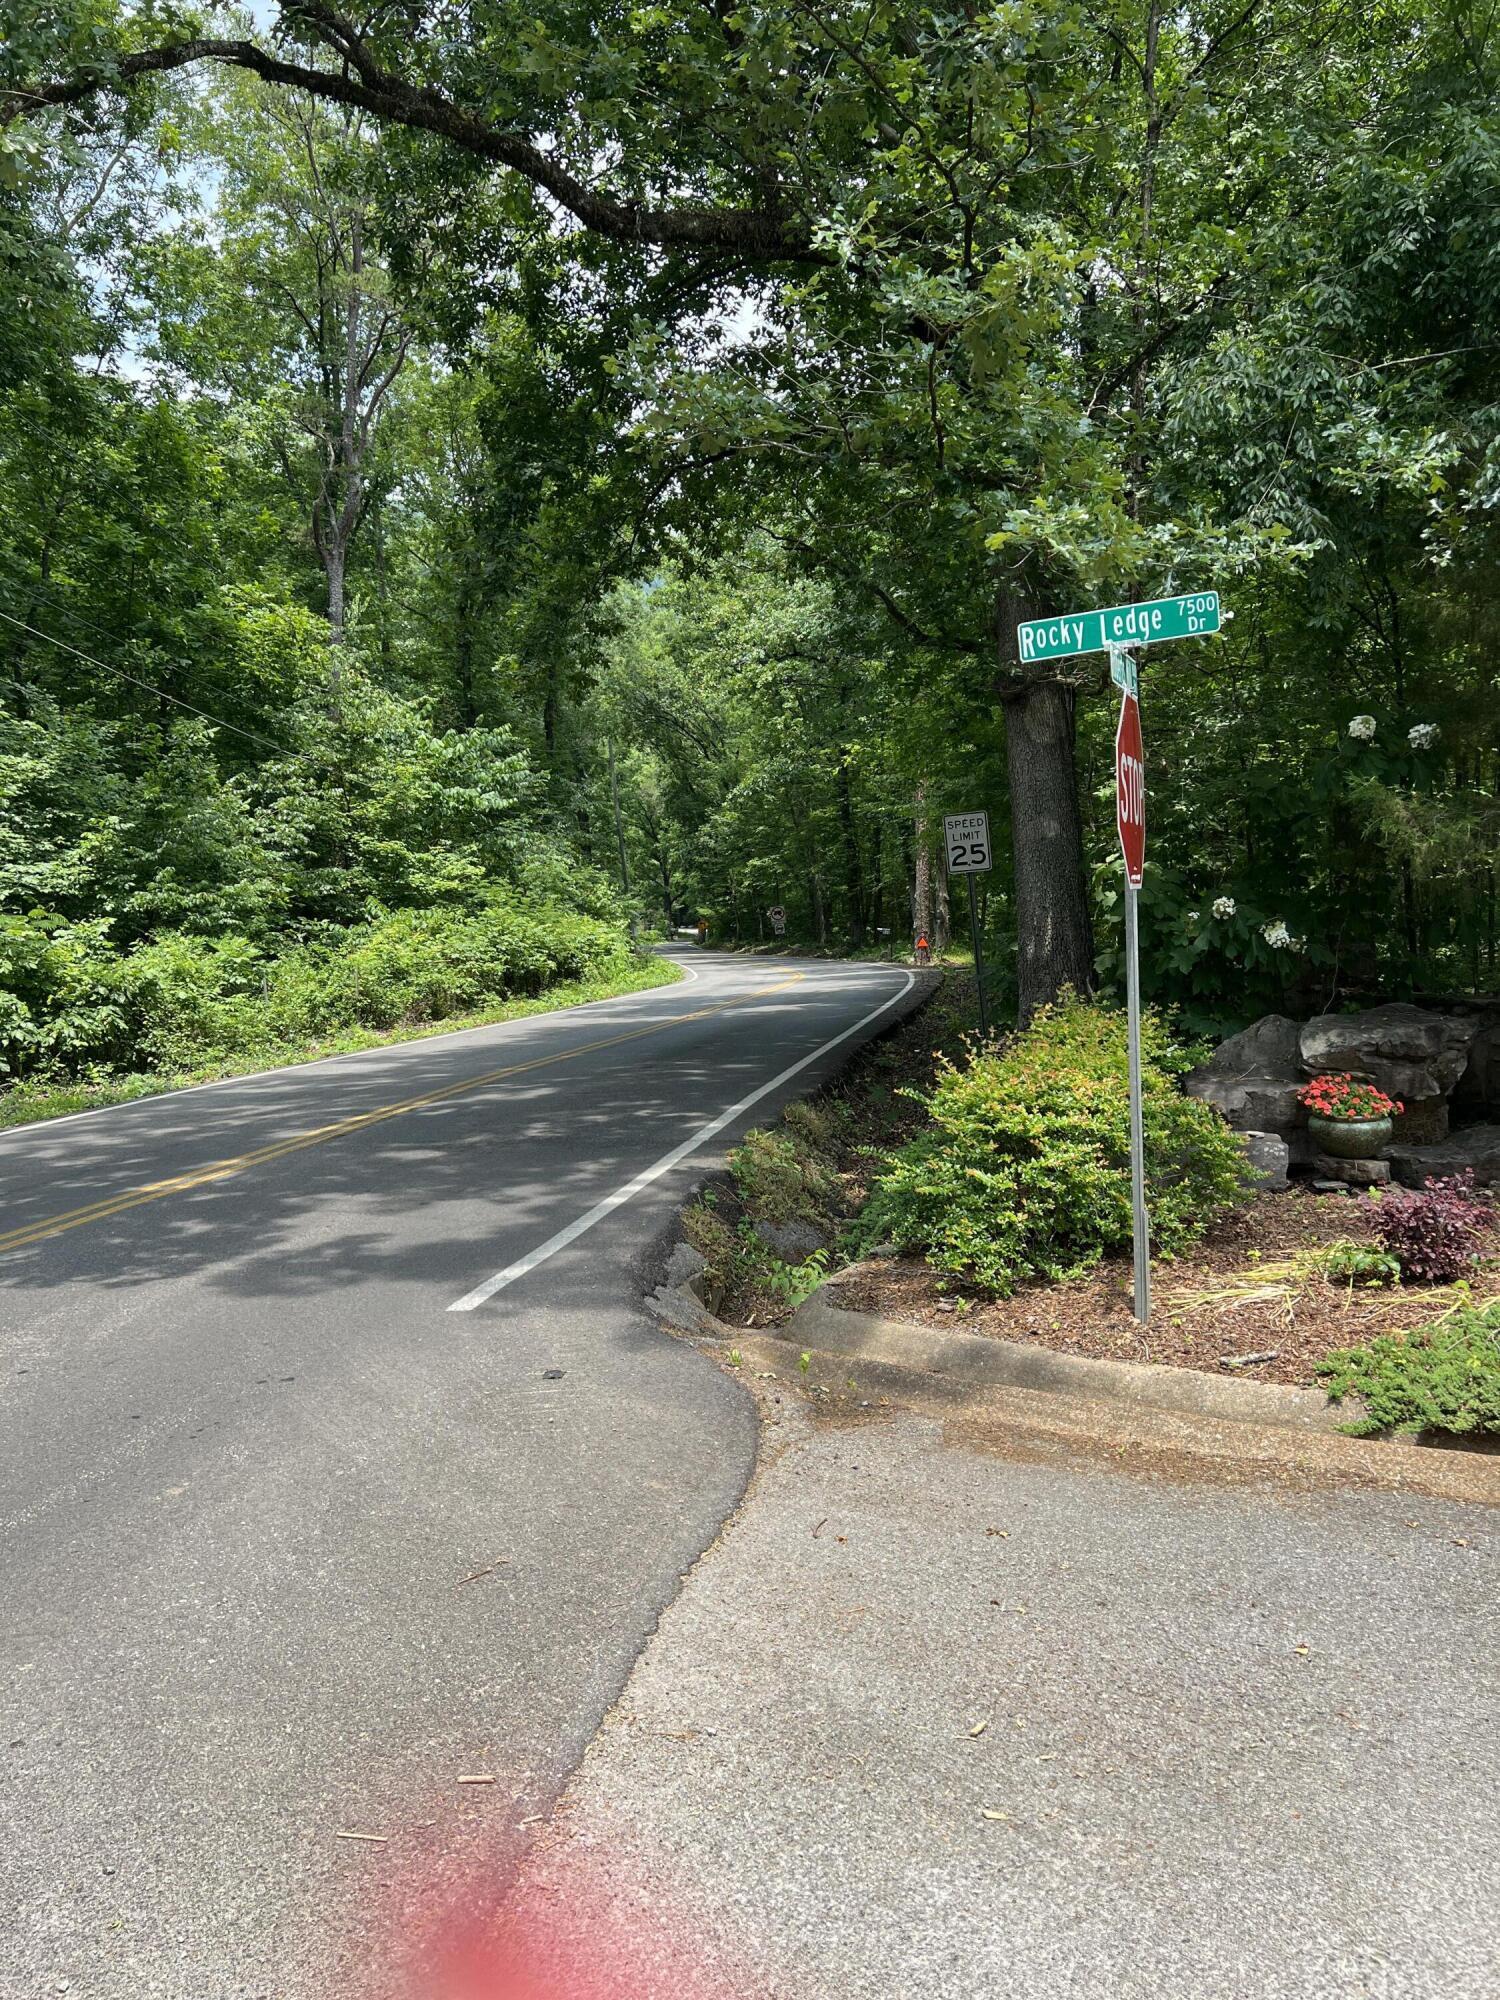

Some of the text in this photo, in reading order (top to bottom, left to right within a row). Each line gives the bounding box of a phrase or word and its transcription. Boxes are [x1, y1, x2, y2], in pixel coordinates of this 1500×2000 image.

[1020, 596, 1215, 658] Rocky Ledge 7500
[1188, 616, 1206, 632] Dr
[1121, 752, 1144, 826] STOP
[947, 818, 984, 830] SPEED
[952, 830, 981, 842] LIMIT
[951, 843, 986, 866] 25
